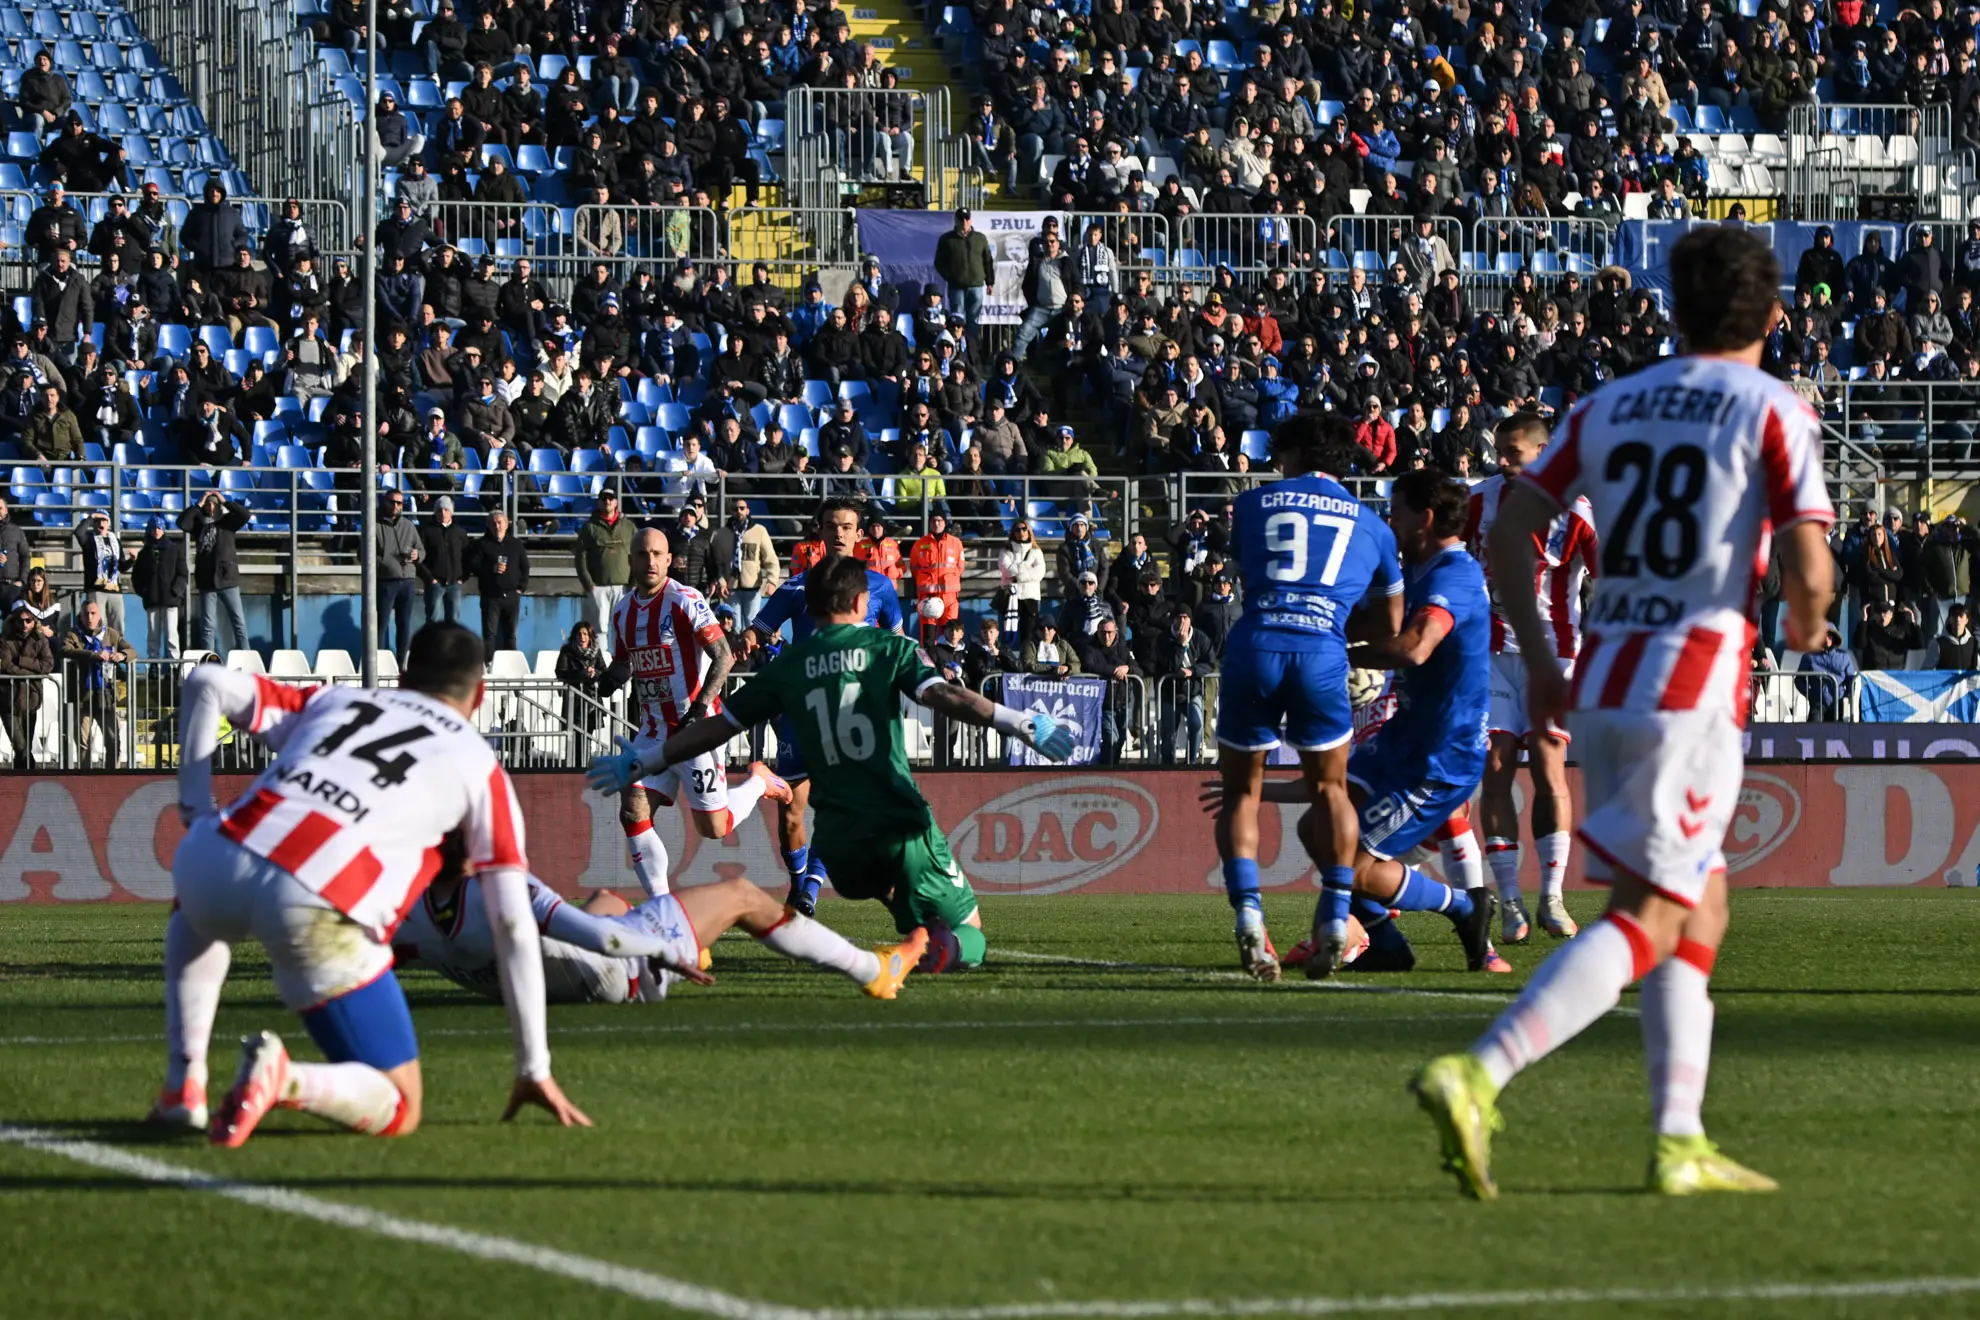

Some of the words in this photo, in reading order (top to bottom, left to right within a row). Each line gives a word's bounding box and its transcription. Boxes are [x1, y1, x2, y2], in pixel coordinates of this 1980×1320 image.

[991, 219, 1035, 229] PAUL
[1609, 385, 1737, 427] CAFERRI
[1261, 492, 1359, 517] CAZZADORI
[1602, 441, 1707, 581] 28
[1265, 511, 1355, 586] 97
[805, 648, 866, 678] GAGNO
[310, 701, 435, 790] 14
[805, 682, 875, 766] 16
[275, 766, 370, 823] NARDI
[691, 768, 717, 793] 32
[1364, 797, 1396, 824] 8
[972, 811, 1118, 862] DAC
